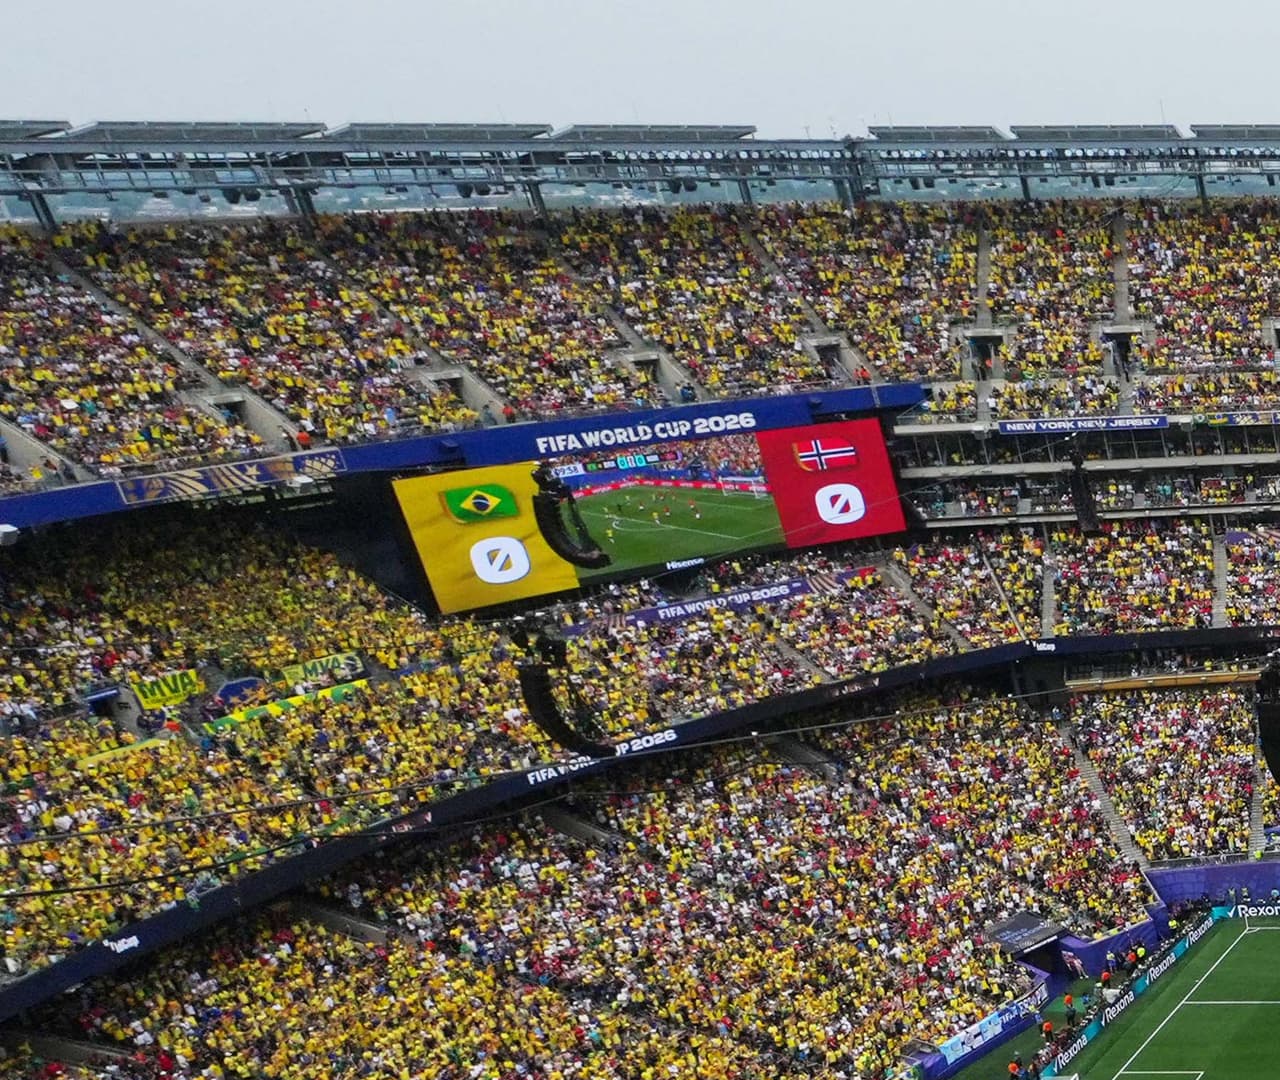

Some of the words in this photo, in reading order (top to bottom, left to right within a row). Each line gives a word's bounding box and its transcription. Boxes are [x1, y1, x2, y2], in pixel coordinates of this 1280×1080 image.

[536, 434, 583, 453] FIFA
[581, 425, 652, 448] WORLD
[654, 420, 691, 439] CUP
[693, 412, 757, 434] 2026
[1006, 421, 1036, 431] NEW
[1038, 420, 1075, 430] YORK
[1077, 418, 1107, 429] NEW
[1109, 416, 1161, 428] JERSEY
[666, 557, 705, 570] Hisense
[658, 605, 685, 620] FIFA
[751, 585, 791, 602] 2026
[630, 729, 678, 752] 2026
[527, 766, 559, 786] FIFA
[1187, 916, 1214, 947] Rexona
[1150, 952, 1176, 982] Rexona
[1105, 990, 1135, 1024] Rexona
[1058, 1034, 1088, 1069] Rexona
